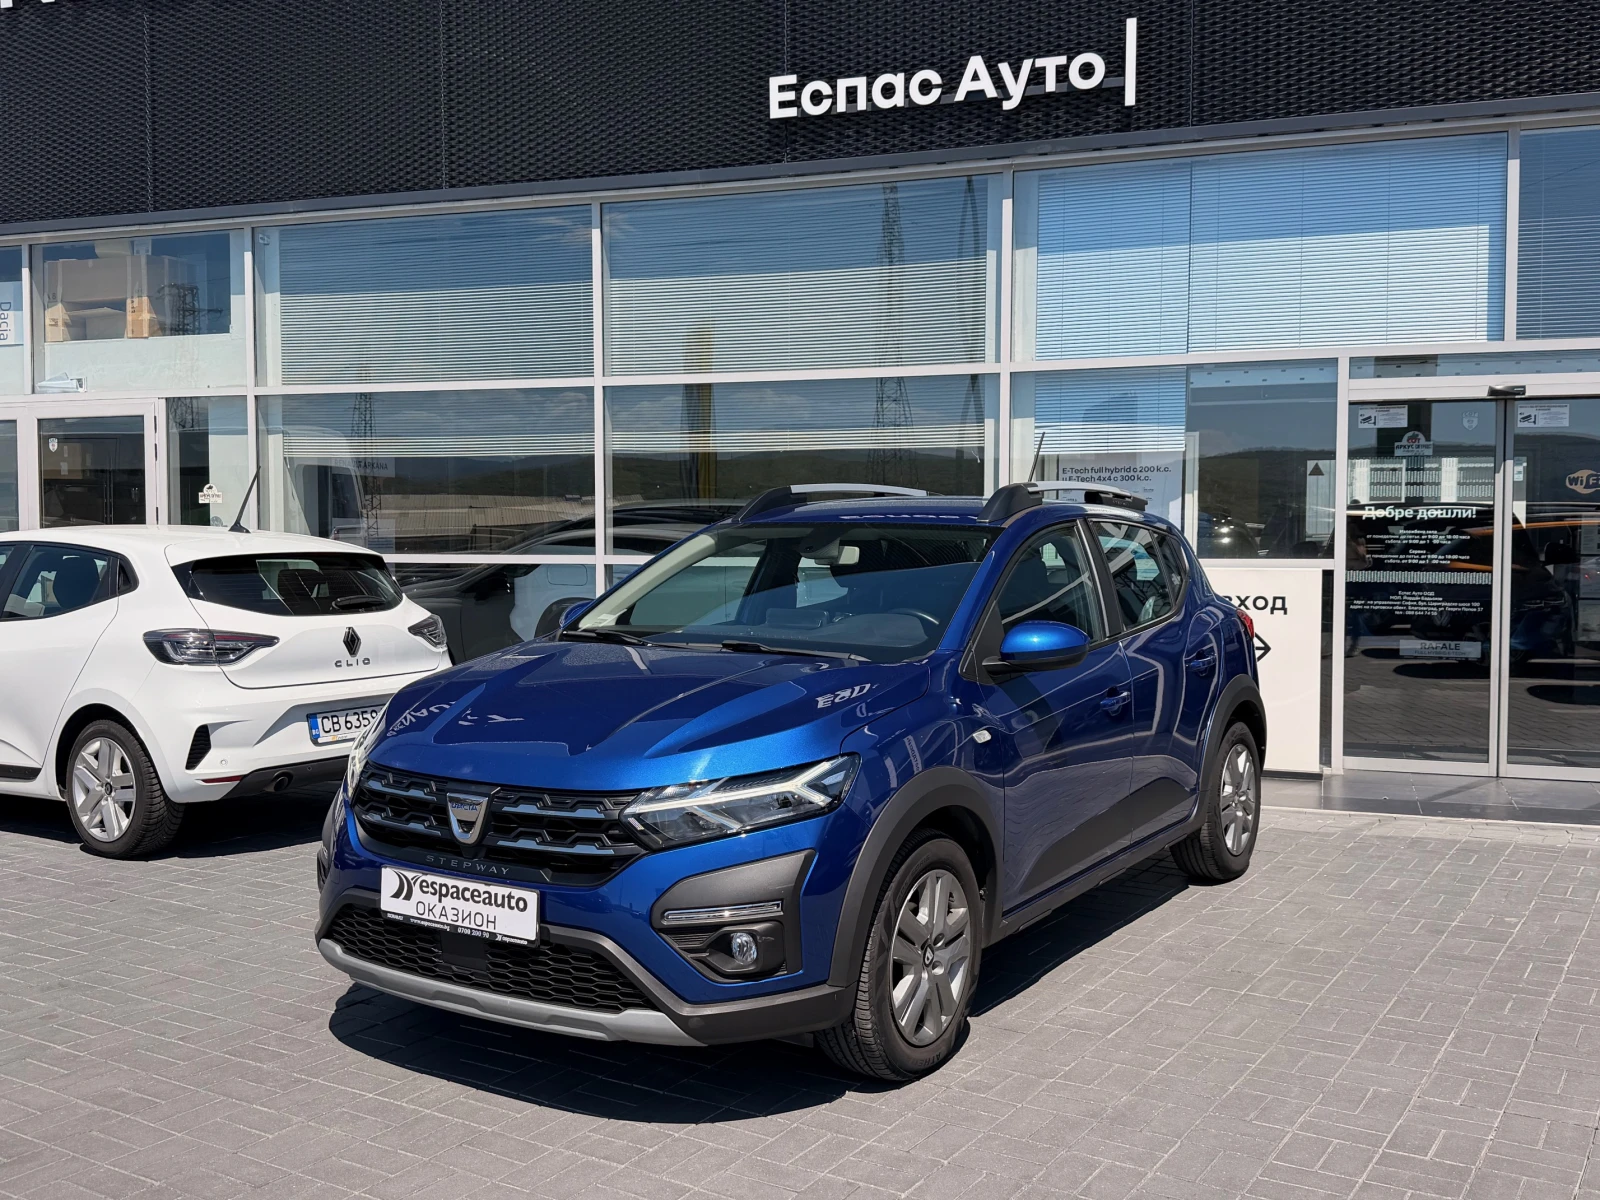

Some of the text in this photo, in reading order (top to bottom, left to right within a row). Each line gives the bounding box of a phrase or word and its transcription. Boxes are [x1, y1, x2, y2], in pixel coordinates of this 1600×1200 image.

[769, 52, 1106, 120] Еспас Ауто
[1062, 466, 1090, 475] E-Tech
[1090, 466, 1104, 474] full
[1106, 465, 1131, 475] hybrid
[1139, 465, 1155, 473] 200
[1068, 474, 1095, 482] E-Tech
[1097, 474, 1113, 482] 4x4
[1120, 474, 1136, 482] 300
[1362, 505, 1477, 521] Добре дошли!
[1420, 642, 1461, 651] RAFALE
[334, 657, 371, 668] CLIO
[425, 855, 509, 875] STEPWAY
[419, 878, 528, 912] espaceauto
[416, 901, 496, 930] ОКАЗИОН
